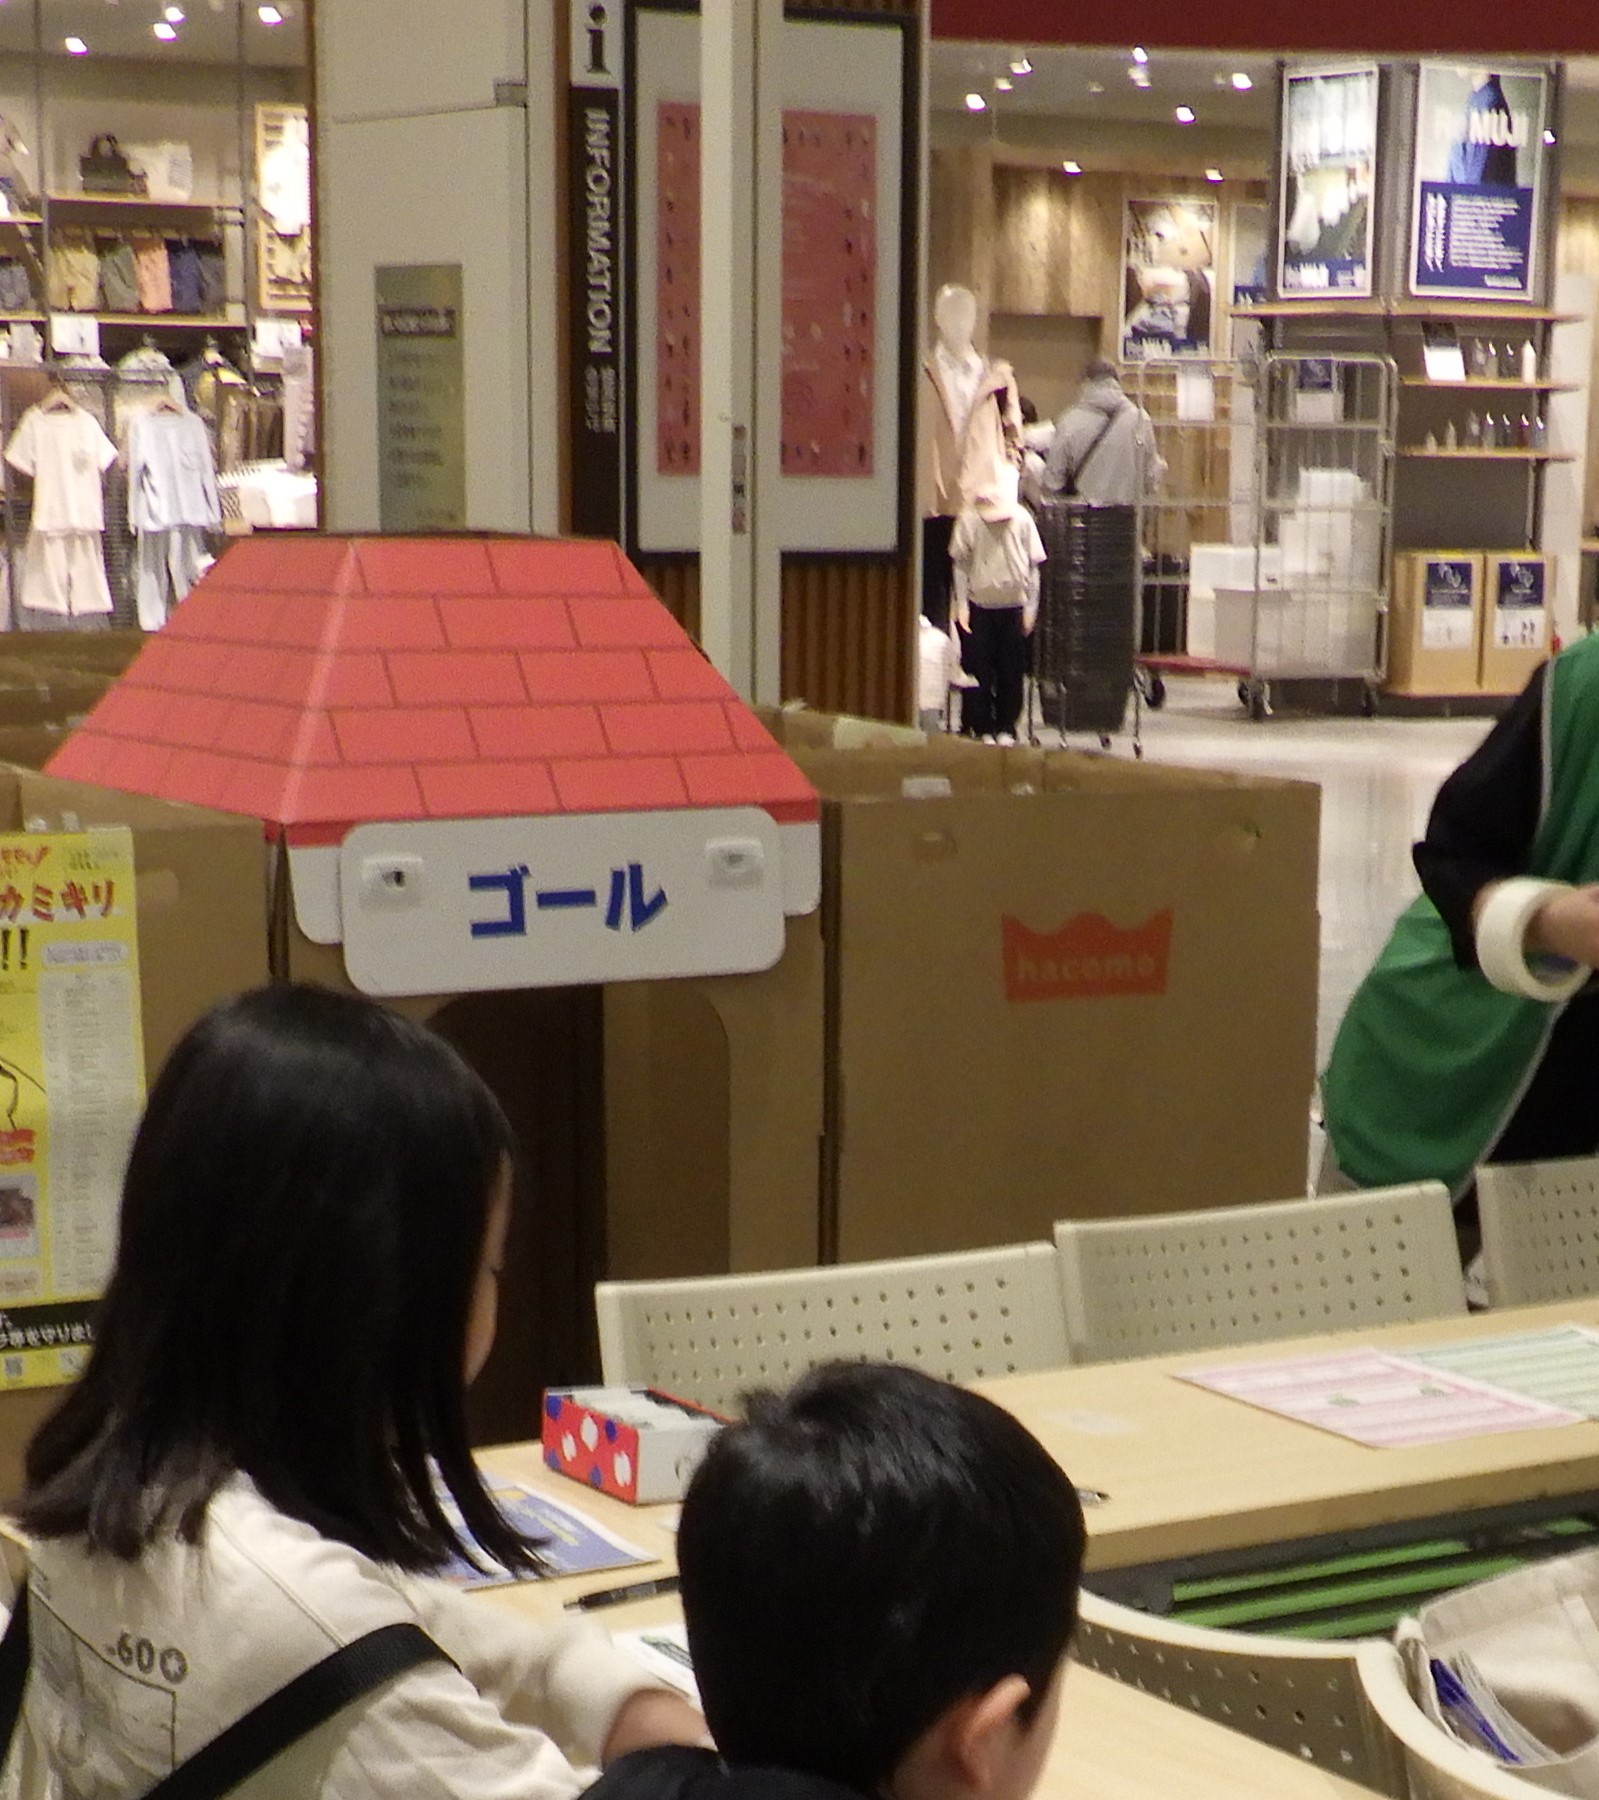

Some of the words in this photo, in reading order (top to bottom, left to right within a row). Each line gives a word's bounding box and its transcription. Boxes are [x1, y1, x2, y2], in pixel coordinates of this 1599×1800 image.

[584, 107, 613, 353] INFORMATION
[468, 859, 669, 938] ゴール
